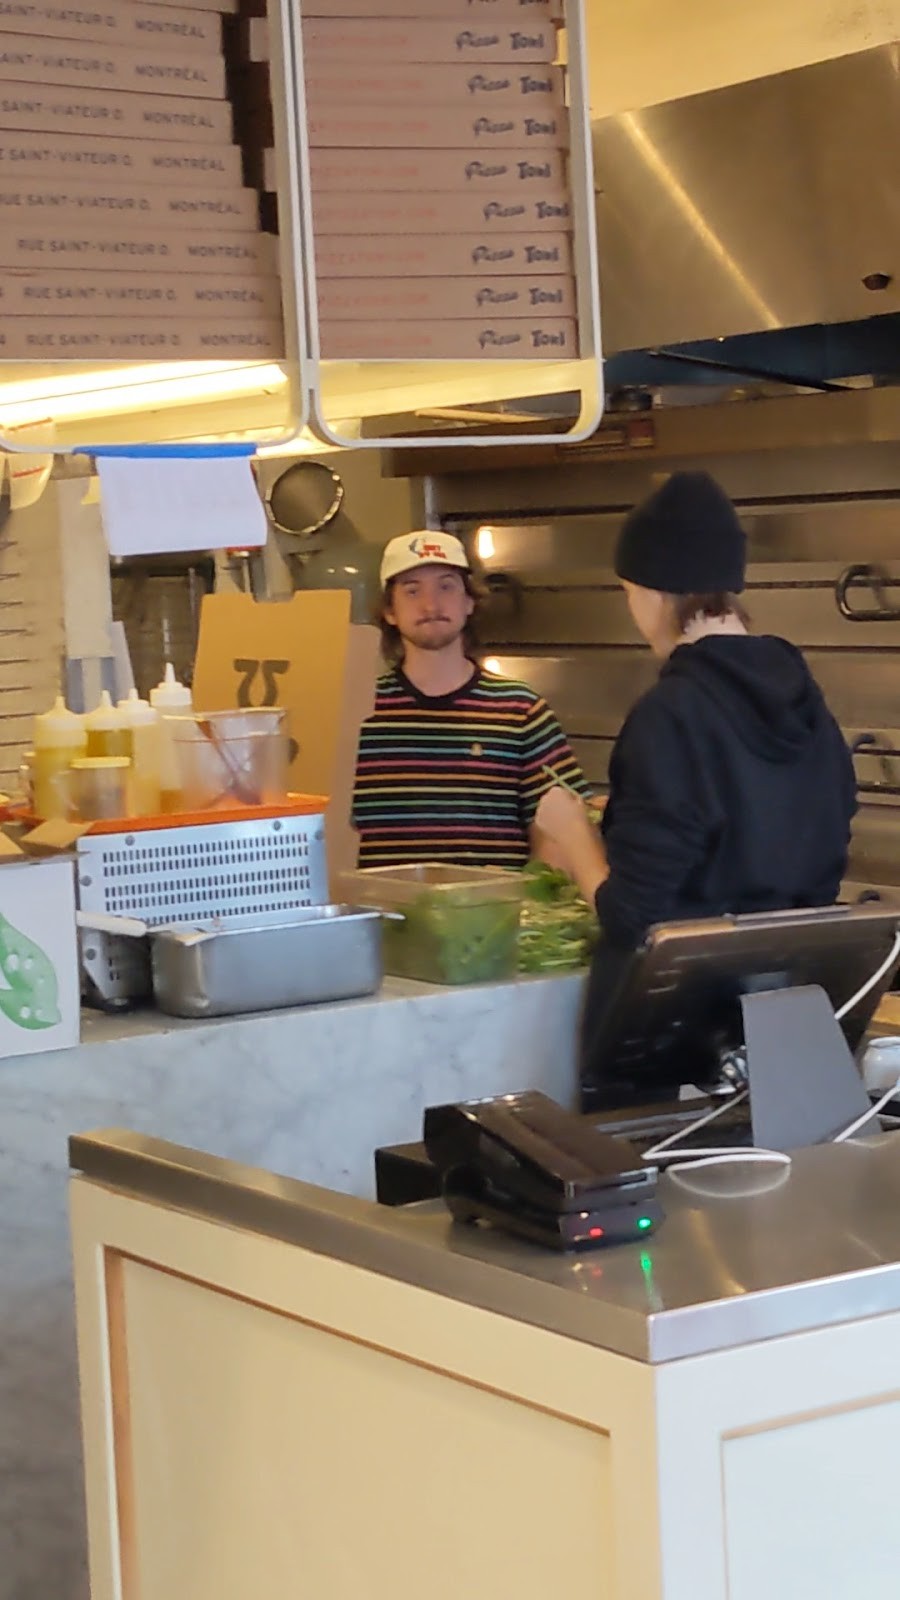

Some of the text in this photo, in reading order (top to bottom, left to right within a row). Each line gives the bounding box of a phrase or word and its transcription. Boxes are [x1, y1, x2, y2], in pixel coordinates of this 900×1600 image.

[0, 53, 102, 72] AINT-VIATEUR
[18, 240, 44, 251] RUE
[24, 287, 51, 299] RUE
[26, 334, 54, 346] RUE
